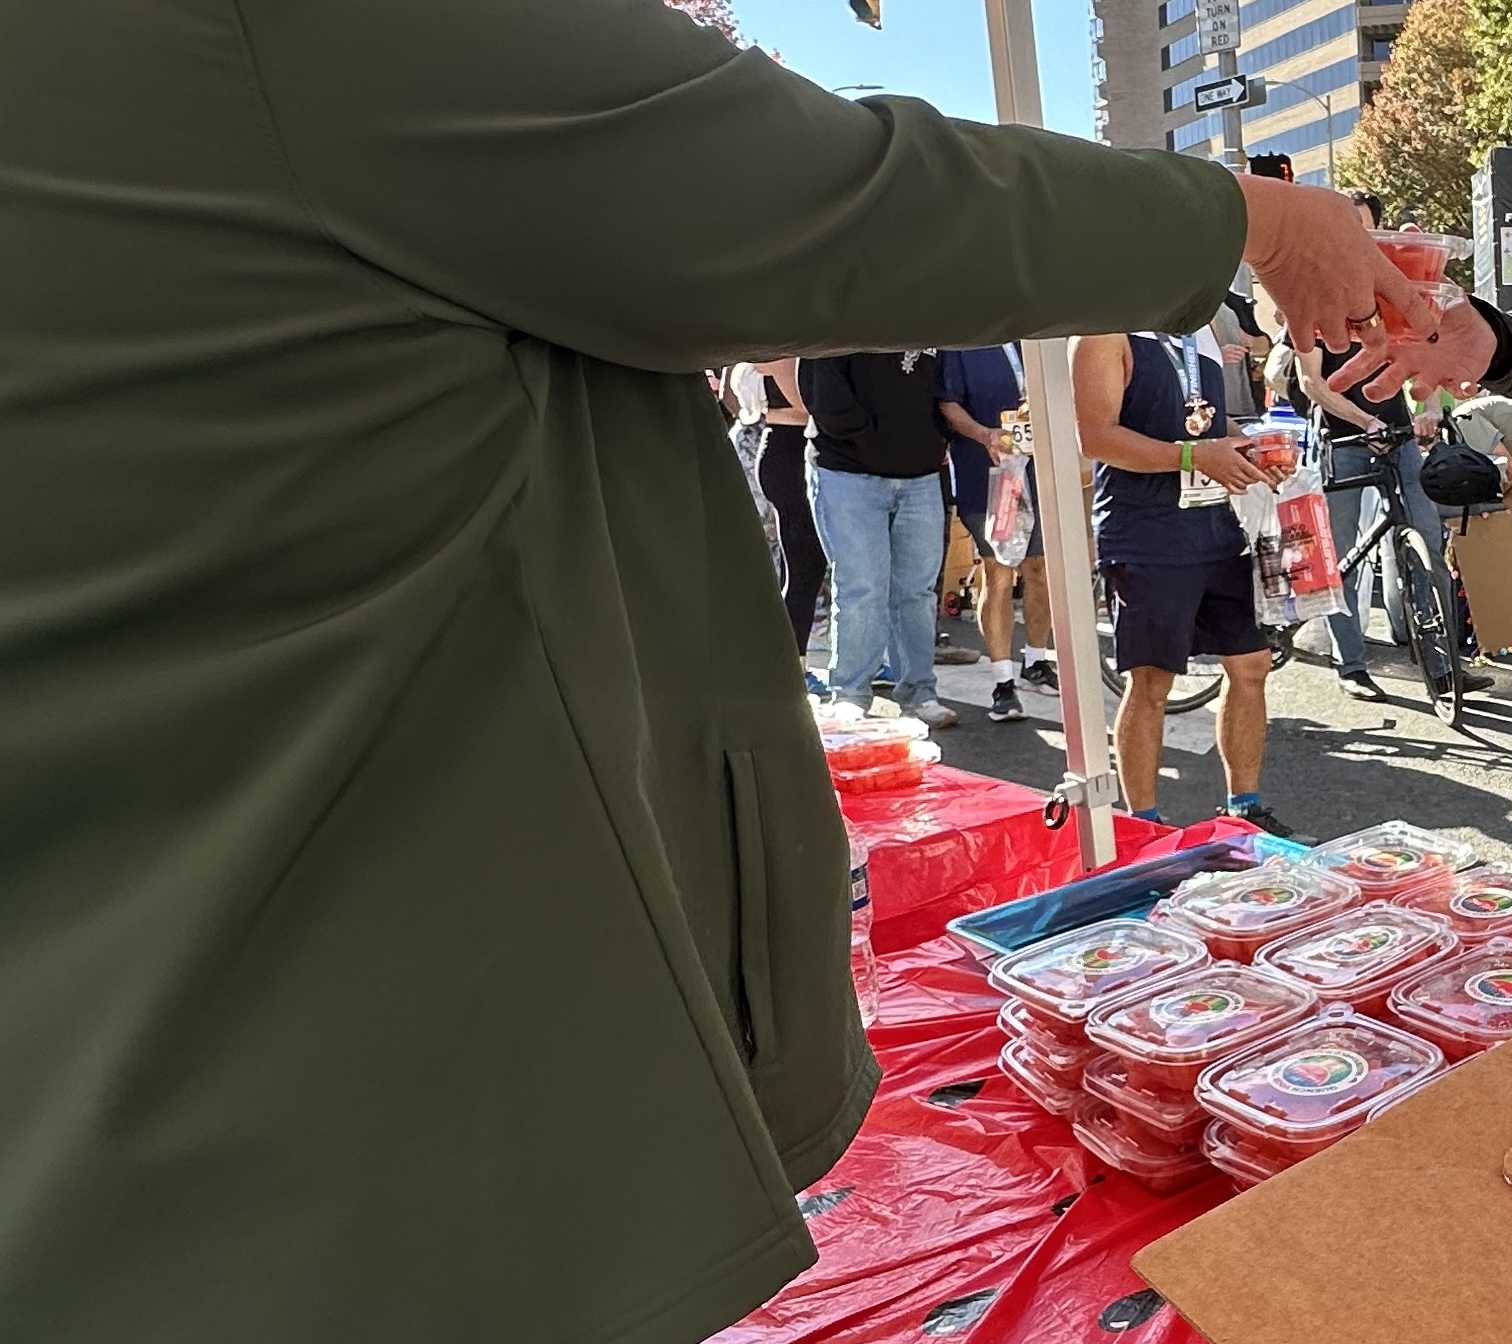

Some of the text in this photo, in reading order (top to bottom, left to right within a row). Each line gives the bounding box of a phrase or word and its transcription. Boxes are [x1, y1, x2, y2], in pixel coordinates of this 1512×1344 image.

[1206, 4, 1231, 17] TURN
[1212, 19, 1227, 32] ON
[1211, 34, 1230, 48] RED
[1200, 90, 1215, 104] ONE
